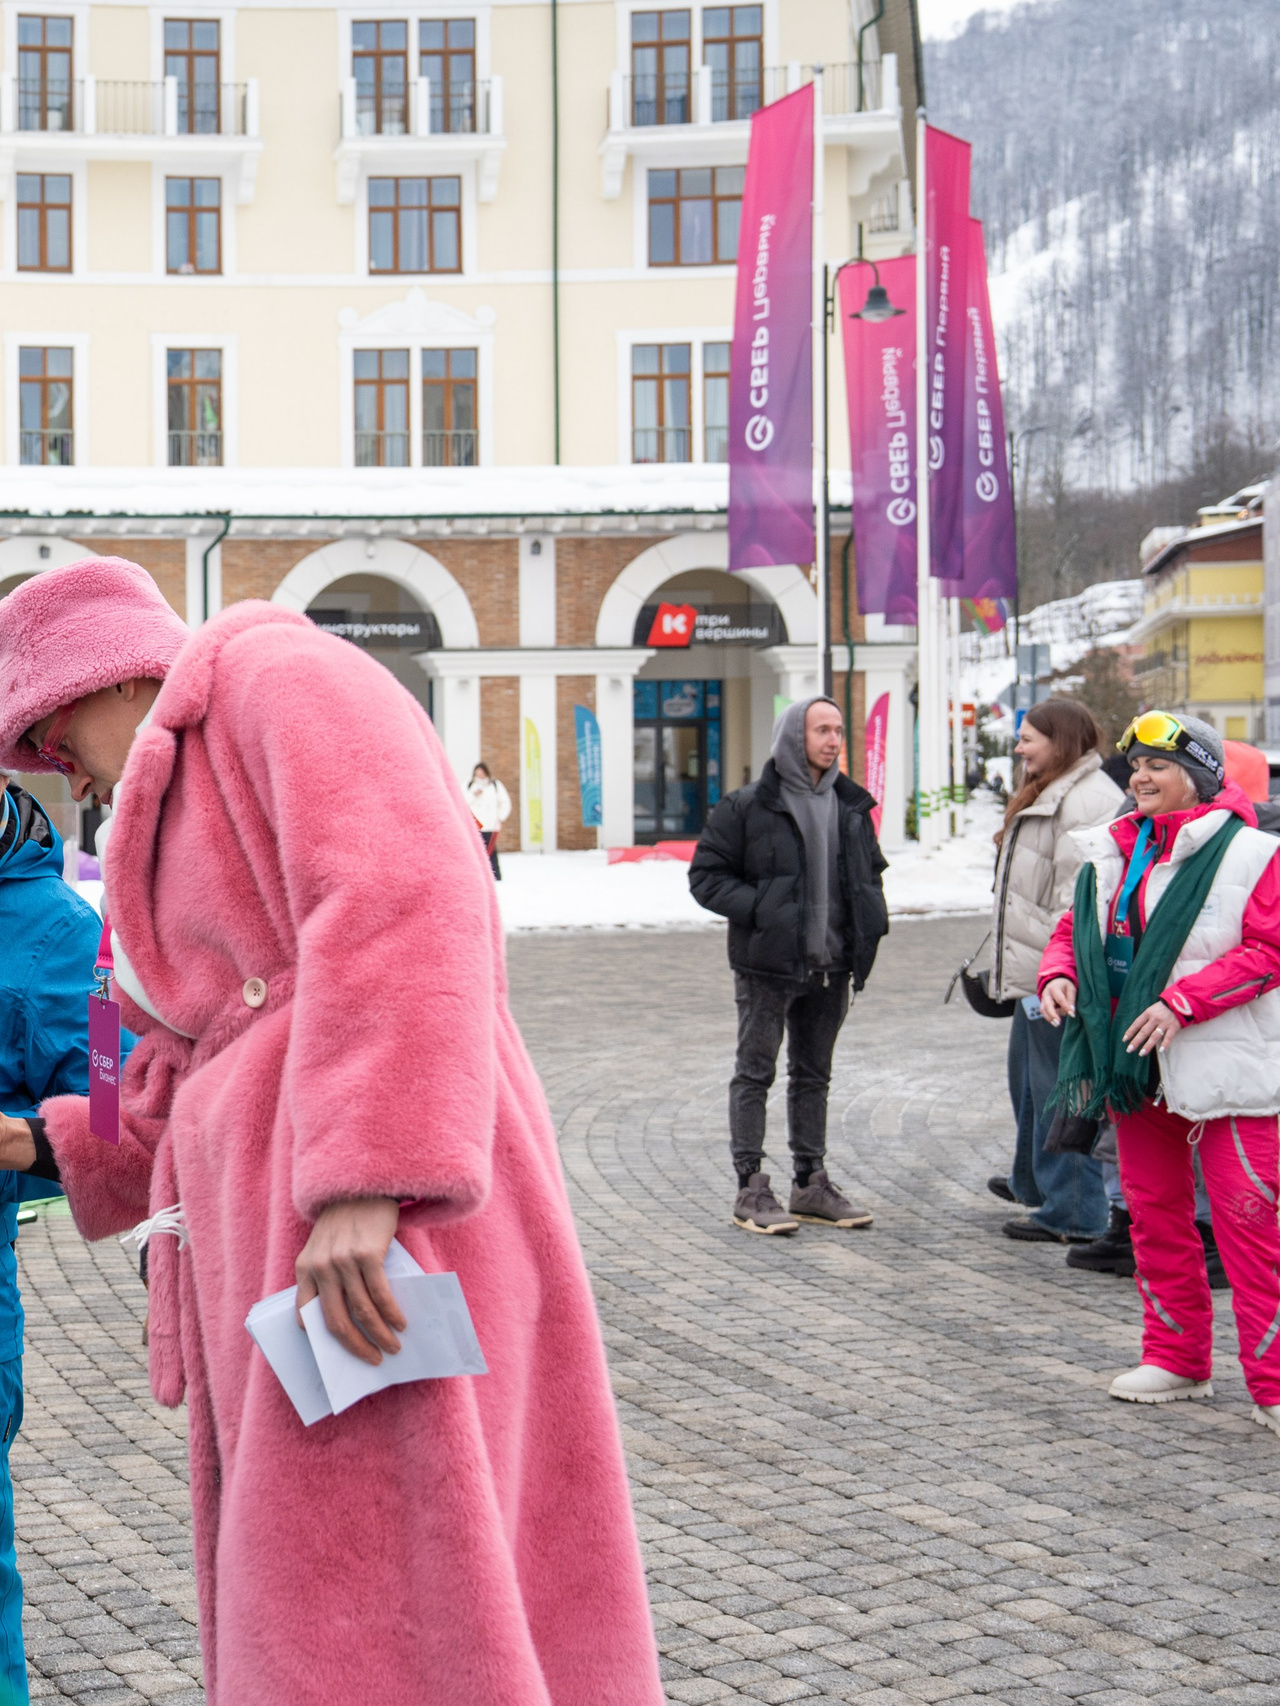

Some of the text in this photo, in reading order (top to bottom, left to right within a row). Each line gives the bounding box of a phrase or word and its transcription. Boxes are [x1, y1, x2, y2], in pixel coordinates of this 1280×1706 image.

[930, 246, 950, 430] СБЕР Первый
[967, 307, 994, 466] СБЕР Первый
[695, 614, 731, 628] три
[695, 627, 769, 642] вершины
[99, 1055, 113, 1069] СБЕР
[99, 1068, 116, 1085] Бизнес
